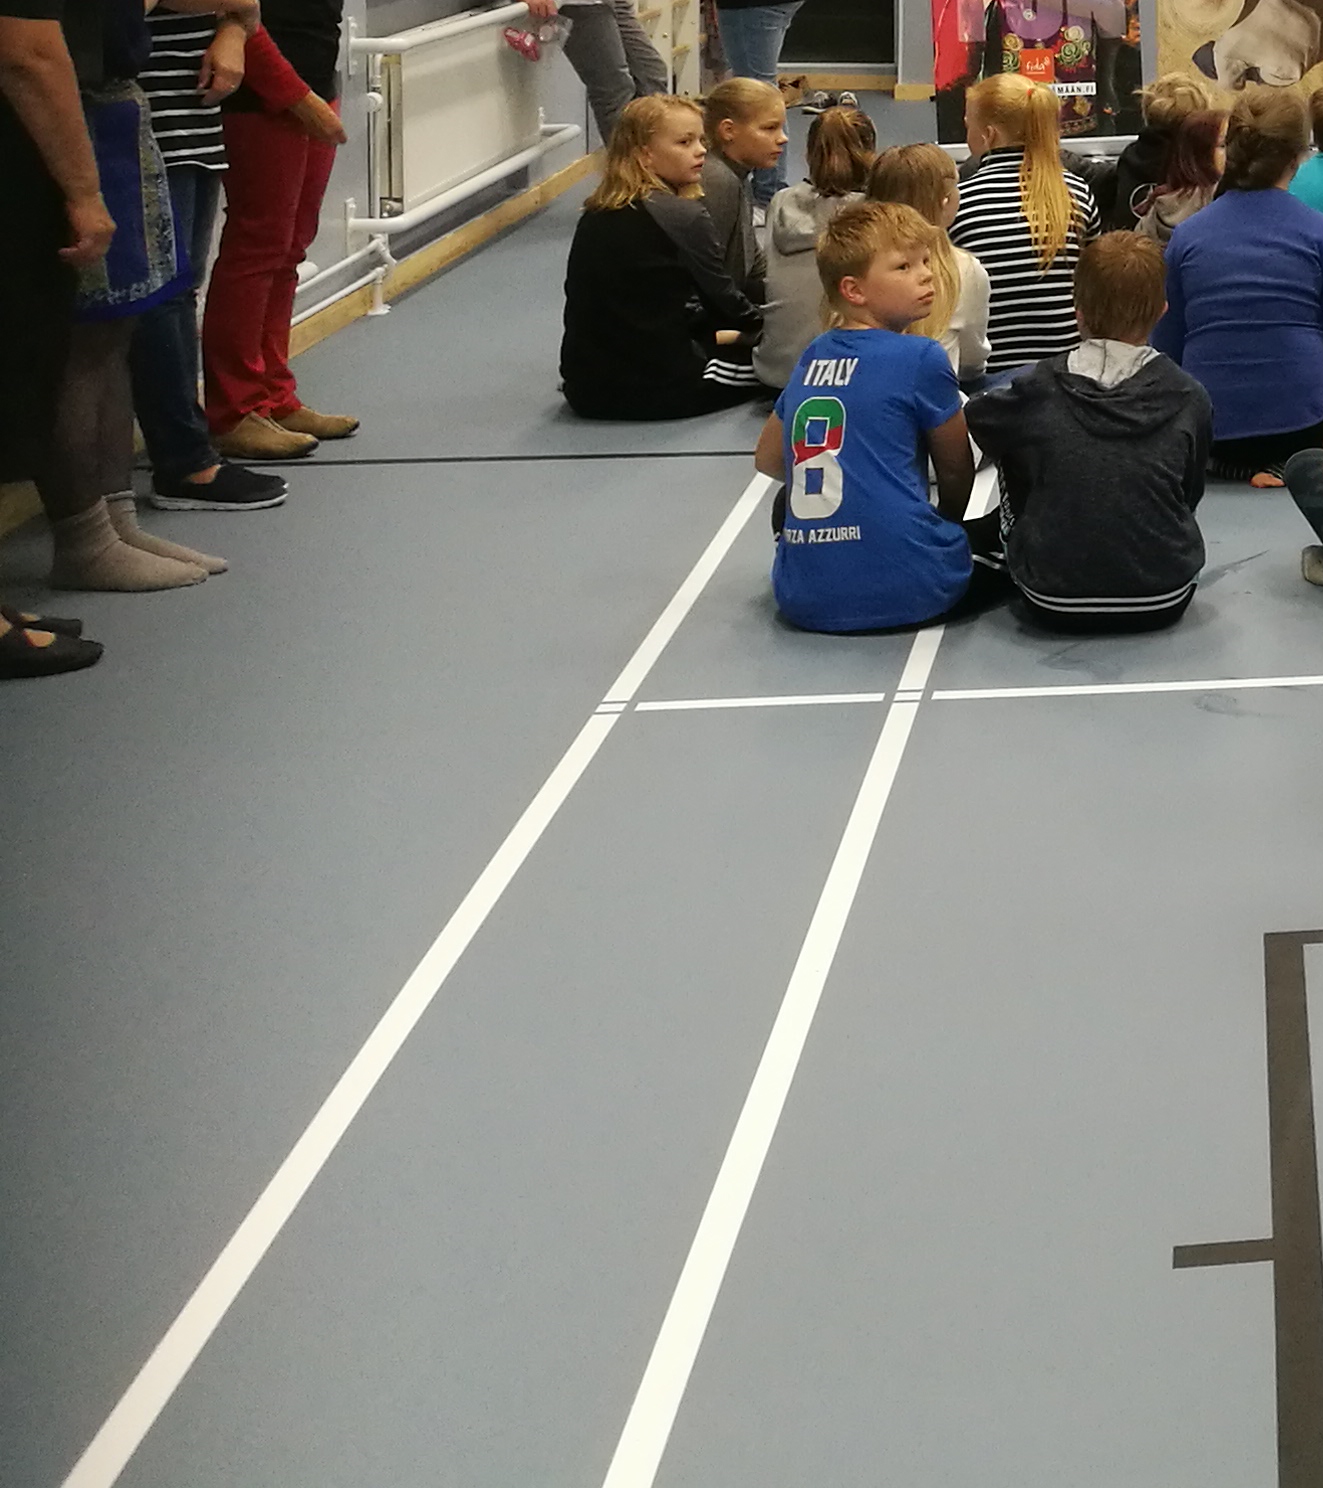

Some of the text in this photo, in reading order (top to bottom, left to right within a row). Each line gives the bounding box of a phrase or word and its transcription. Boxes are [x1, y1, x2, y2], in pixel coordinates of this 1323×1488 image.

[803, 357, 859, 386] ITALY
[790, 396, 846, 519] 8
[808, 524, 861, 544] AZZURRI
